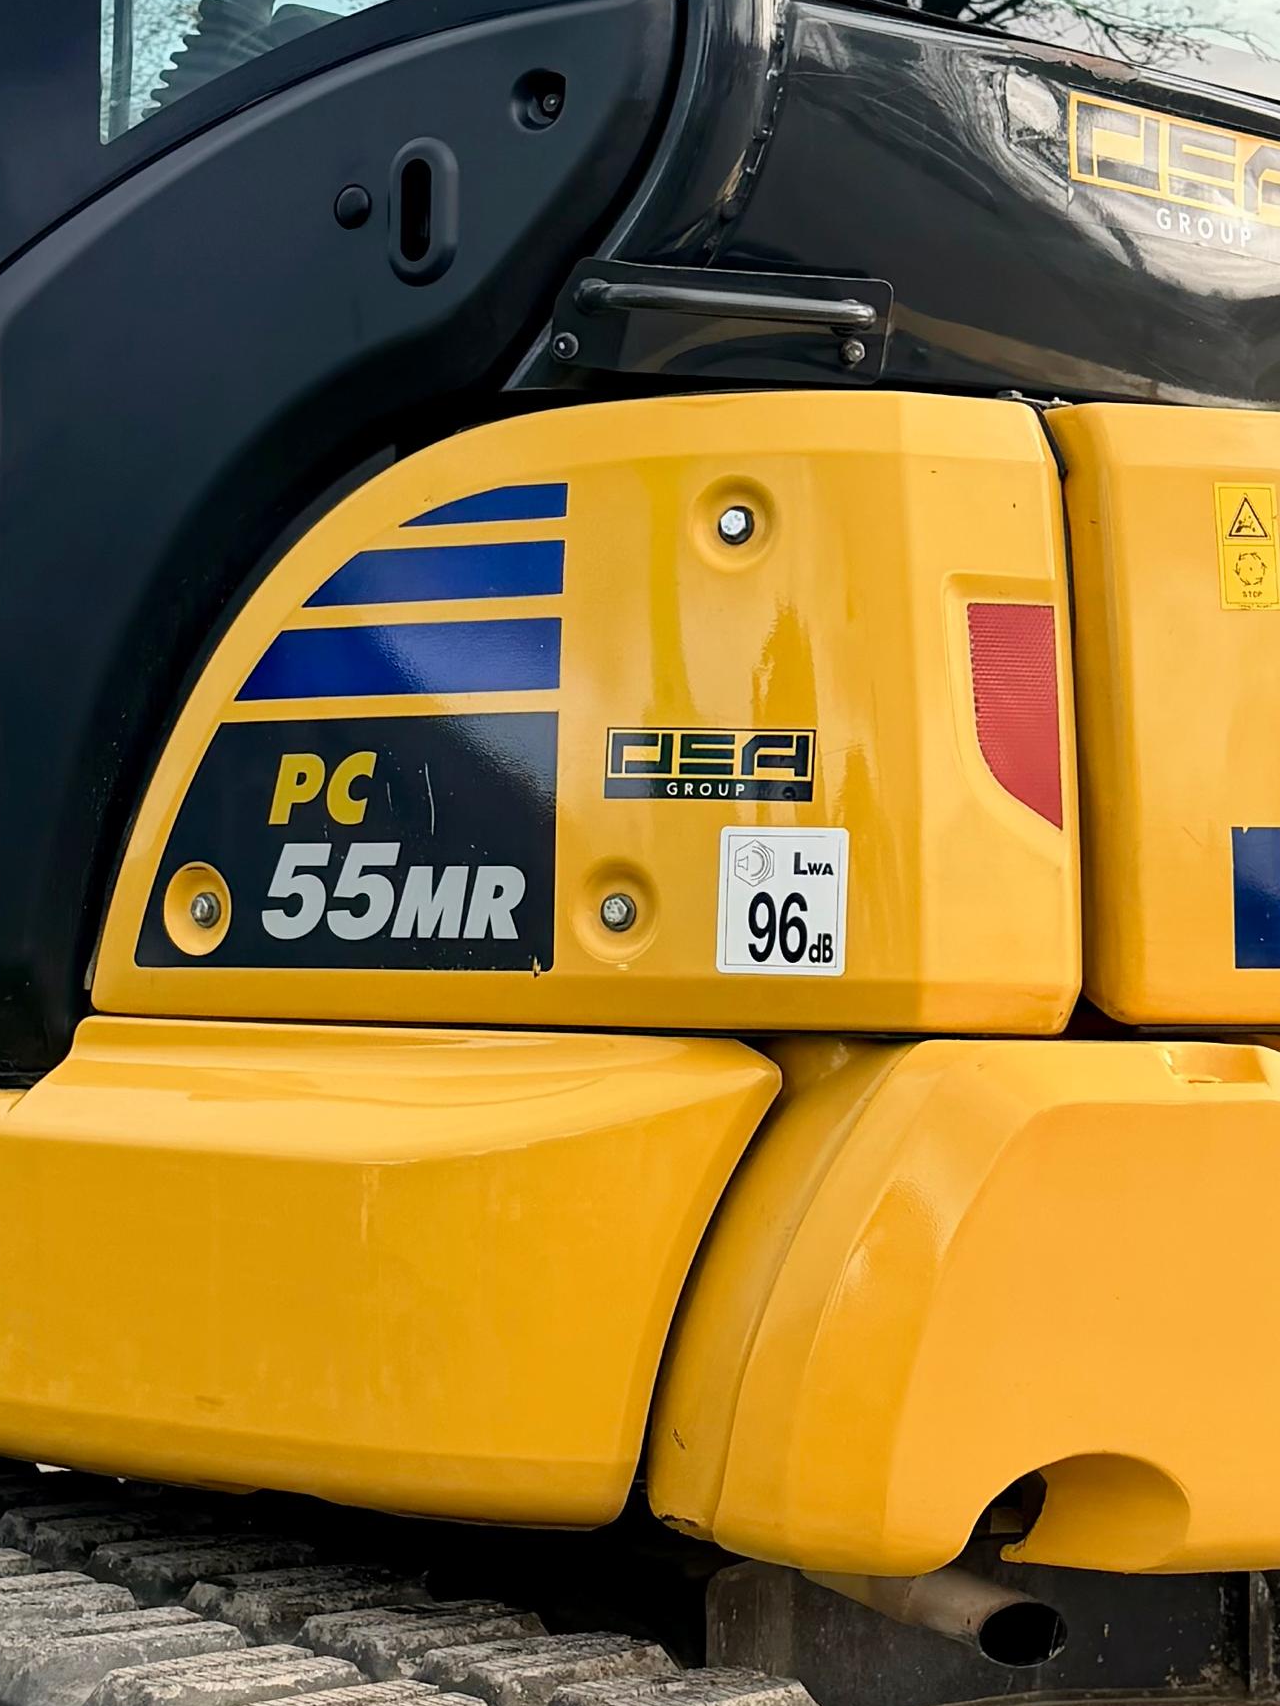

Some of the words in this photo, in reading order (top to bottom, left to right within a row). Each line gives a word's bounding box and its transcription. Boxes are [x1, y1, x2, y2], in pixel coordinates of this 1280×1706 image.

[1155, 207, 1253, 248] GROUP
[268, 751, 377, 825] PC
[666, 782, 746, 797] GROUP
[261, 842, 526, 941] 55MR
[748, 891, 808, 964] 96
[808, 933, 834, 964] dB
